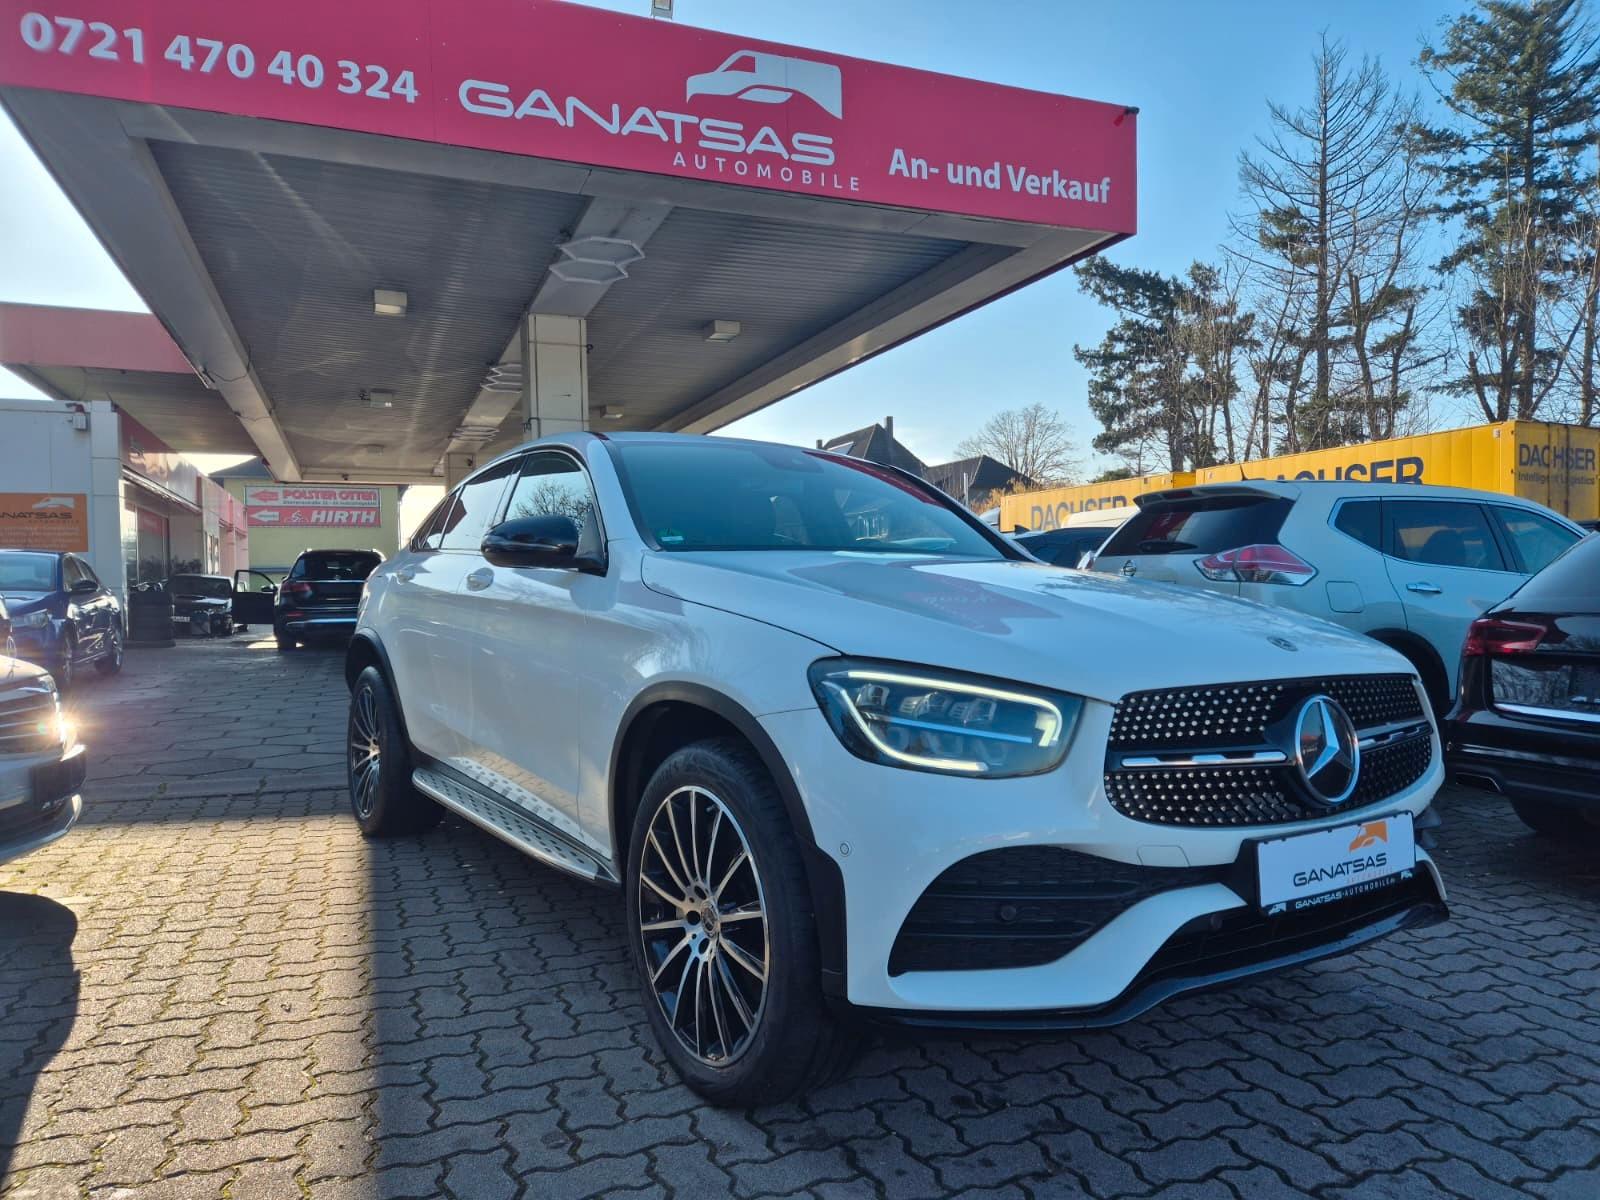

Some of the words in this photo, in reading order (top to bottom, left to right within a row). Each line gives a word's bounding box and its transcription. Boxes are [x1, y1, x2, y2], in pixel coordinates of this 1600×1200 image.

[20, 12, 145, 64] 0721
[164, 34, 256, 79] 470
[267, 50, 325, 88] 40
[337, 60, 419, 103] 324
[458, 79, 835, 166] GANATSAS
[673, 151, 860, 192] AUTOMOBILE
[888, 148, 940, 180] An-
[947, 161, 1001, 190] und
[1006, 164, 1111, 204] Verkauf
[1518, 443, 1596, 471] DACHSER
[282, 489, 337, 500] POLSTER
[311, 510, 377, 523] HIRTH
[1293, 852, 1388, 887] GANATSAS
